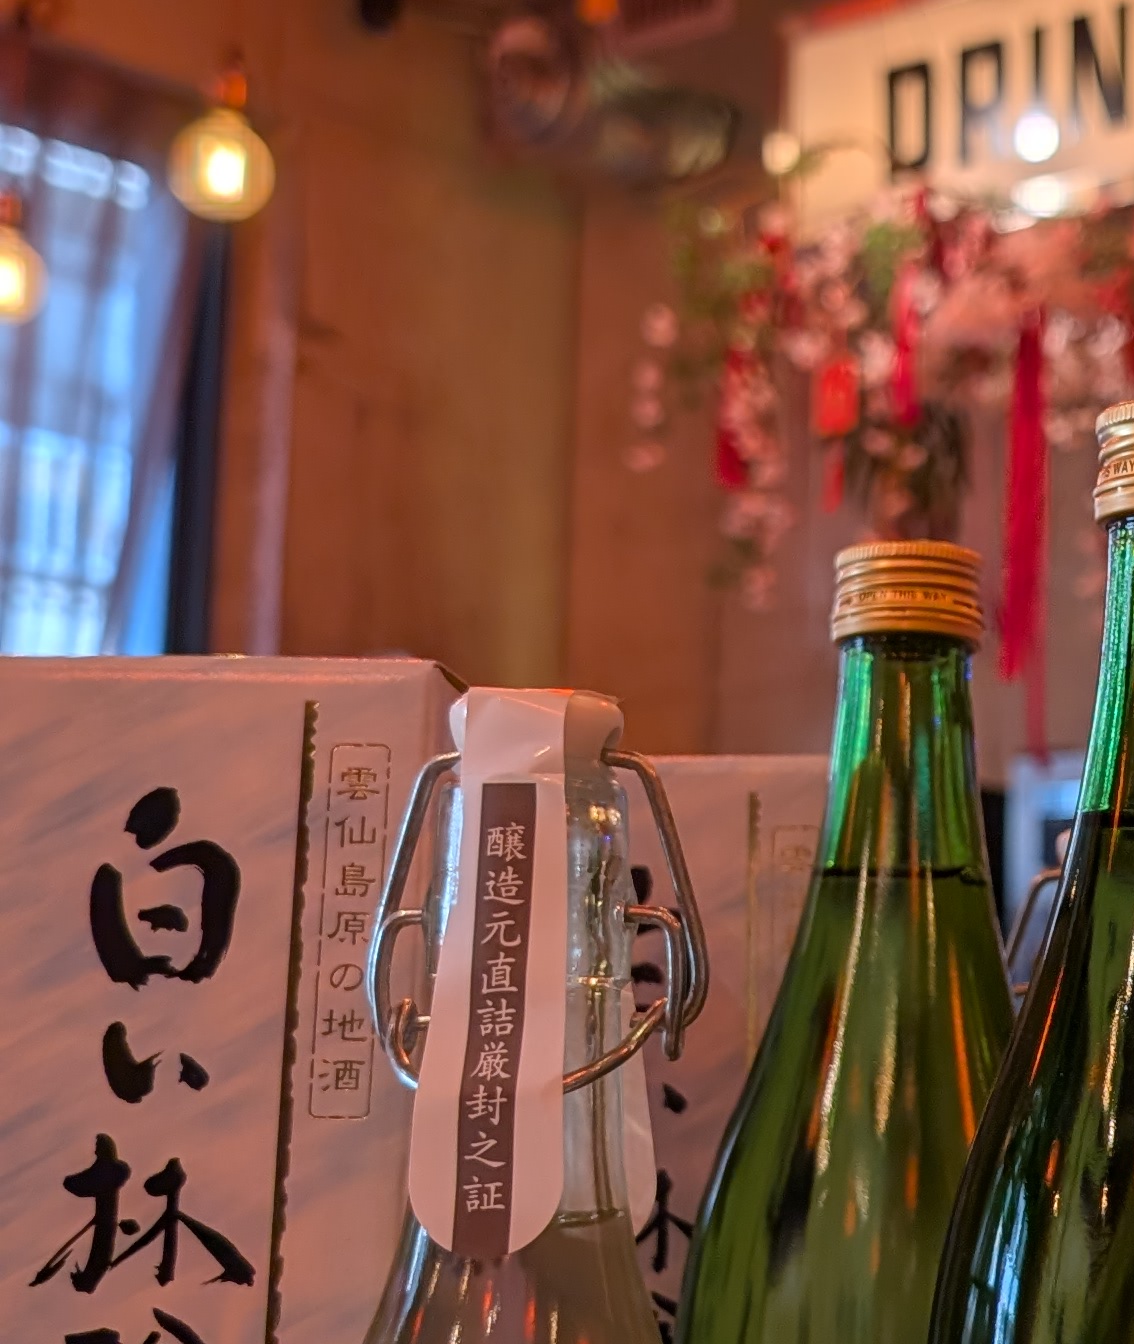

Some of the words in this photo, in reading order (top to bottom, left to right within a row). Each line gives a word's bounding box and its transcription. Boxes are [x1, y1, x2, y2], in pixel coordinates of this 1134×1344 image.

[316, 764, 380, 1094] 雲仙島原の地酒
[461, 821, 528, 1214] 醸造元直詰厳封之証
